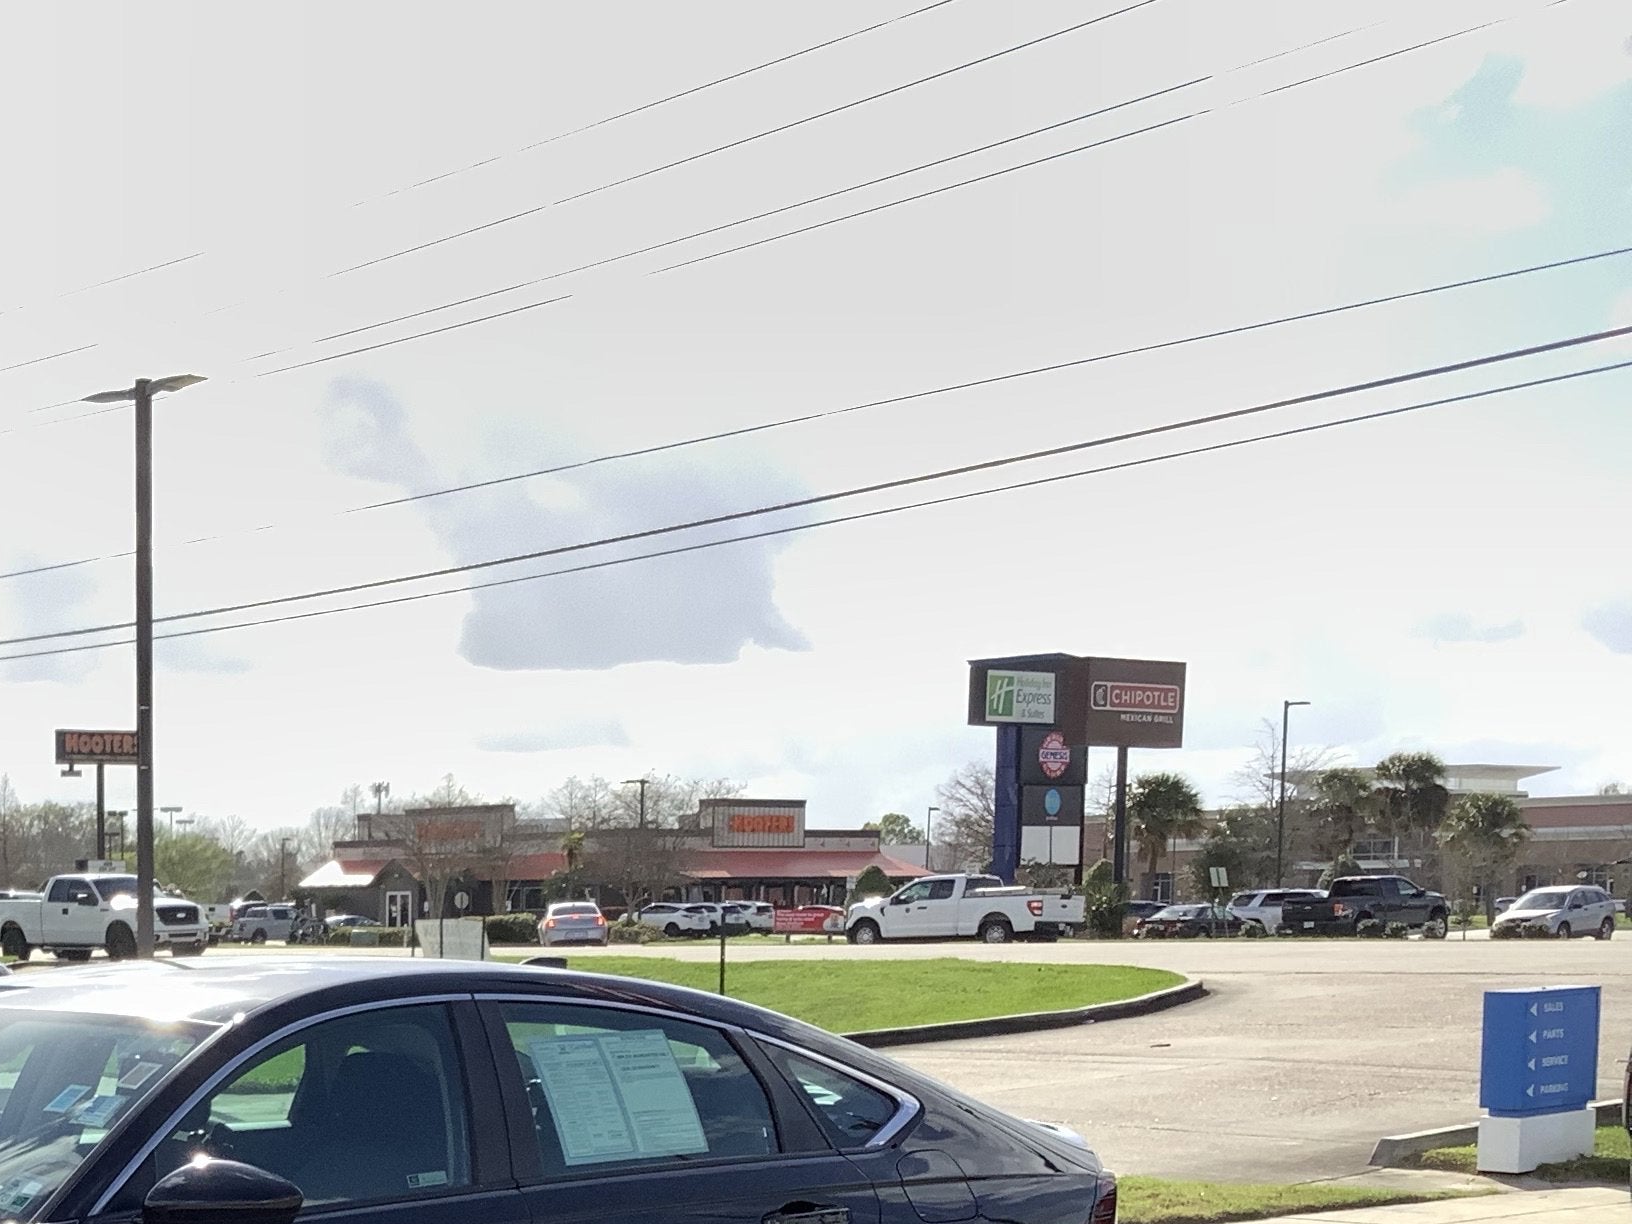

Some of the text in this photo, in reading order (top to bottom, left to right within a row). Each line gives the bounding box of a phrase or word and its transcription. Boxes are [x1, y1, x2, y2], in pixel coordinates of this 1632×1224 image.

[1016, 688, 1052, 707] Express
[1111, 689, 1176, 707] CHIPOTLE
[1120, 713, 1152, 723] MEXICAN
[1041, 750, 1068, 760] GENESIS
[1543, 1029, 1564, 1039] PARTS
[1542, 1055, 1568, 1067] SERVICE
[1540, 1083, 1568, 1094] PARKING
